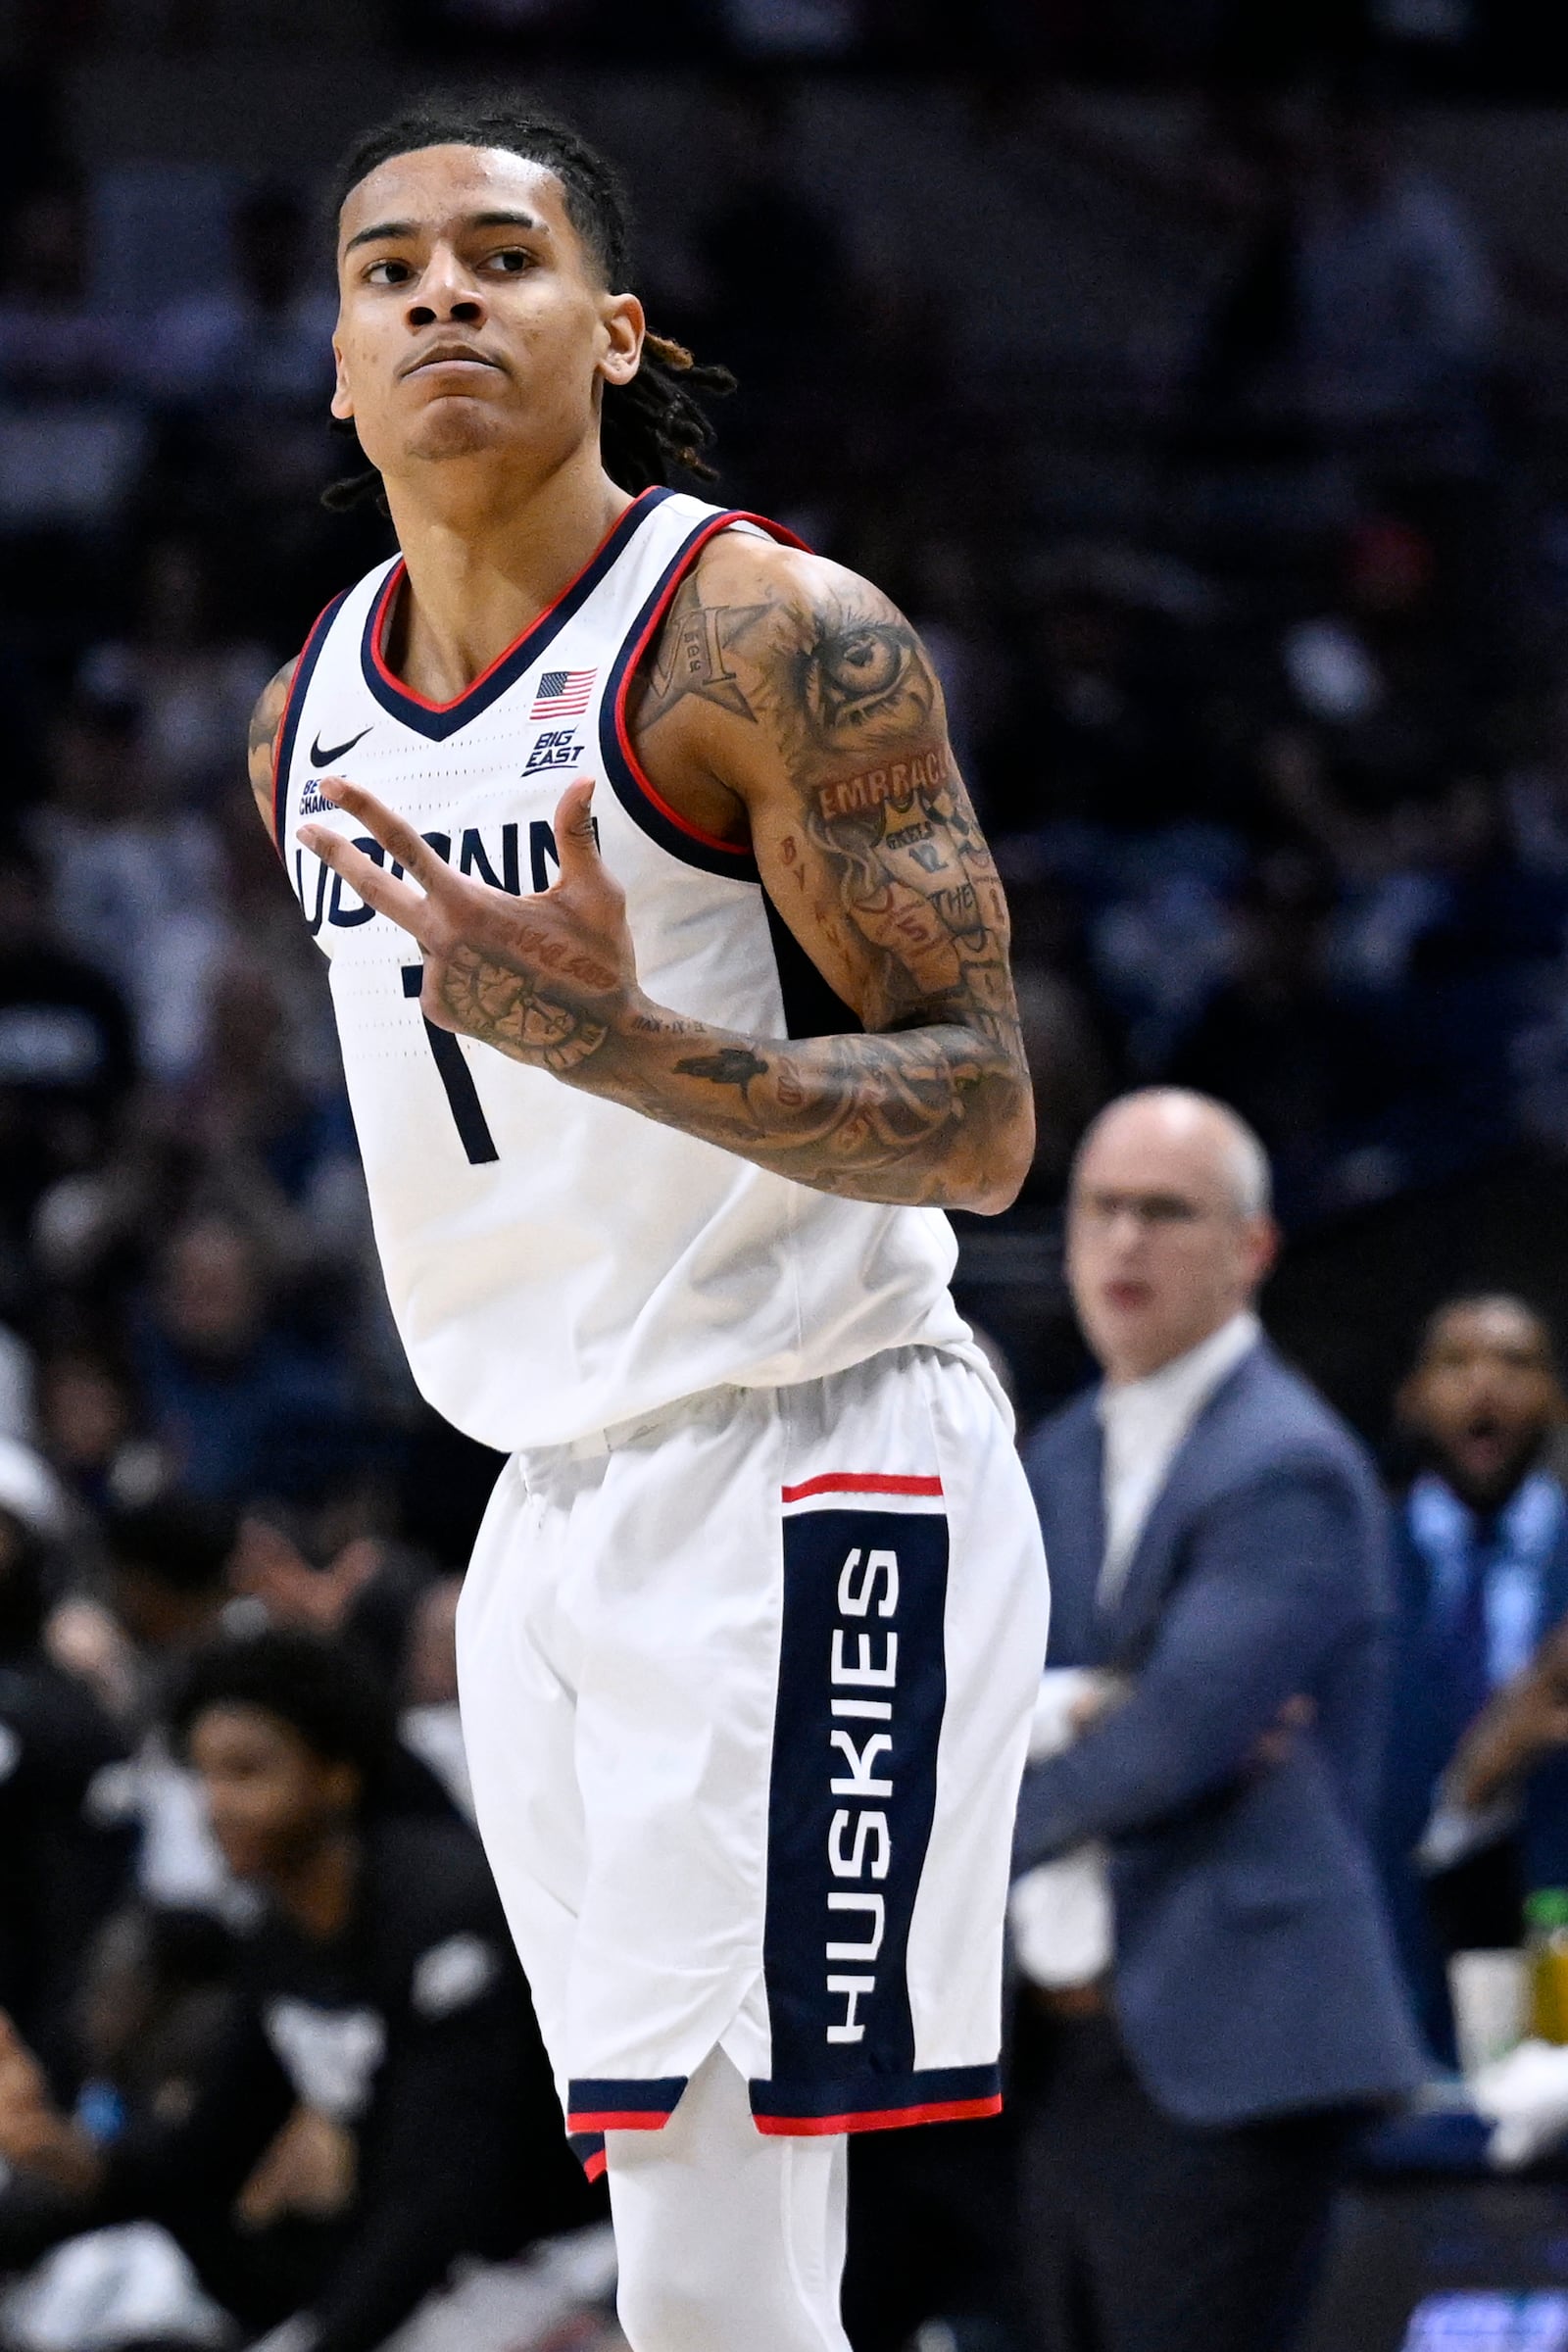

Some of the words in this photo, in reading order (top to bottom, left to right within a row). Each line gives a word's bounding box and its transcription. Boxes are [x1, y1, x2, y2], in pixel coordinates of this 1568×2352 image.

[533, 725, 578, 750] BIG
[525, 746, 585, 767] EAST
[303, 778, 321, 796] BE
[299, 794, 340, 815] CHANG
[401, 964, 501, 1165] 1
[826, 1546, 901, 2045] HUSKIES
